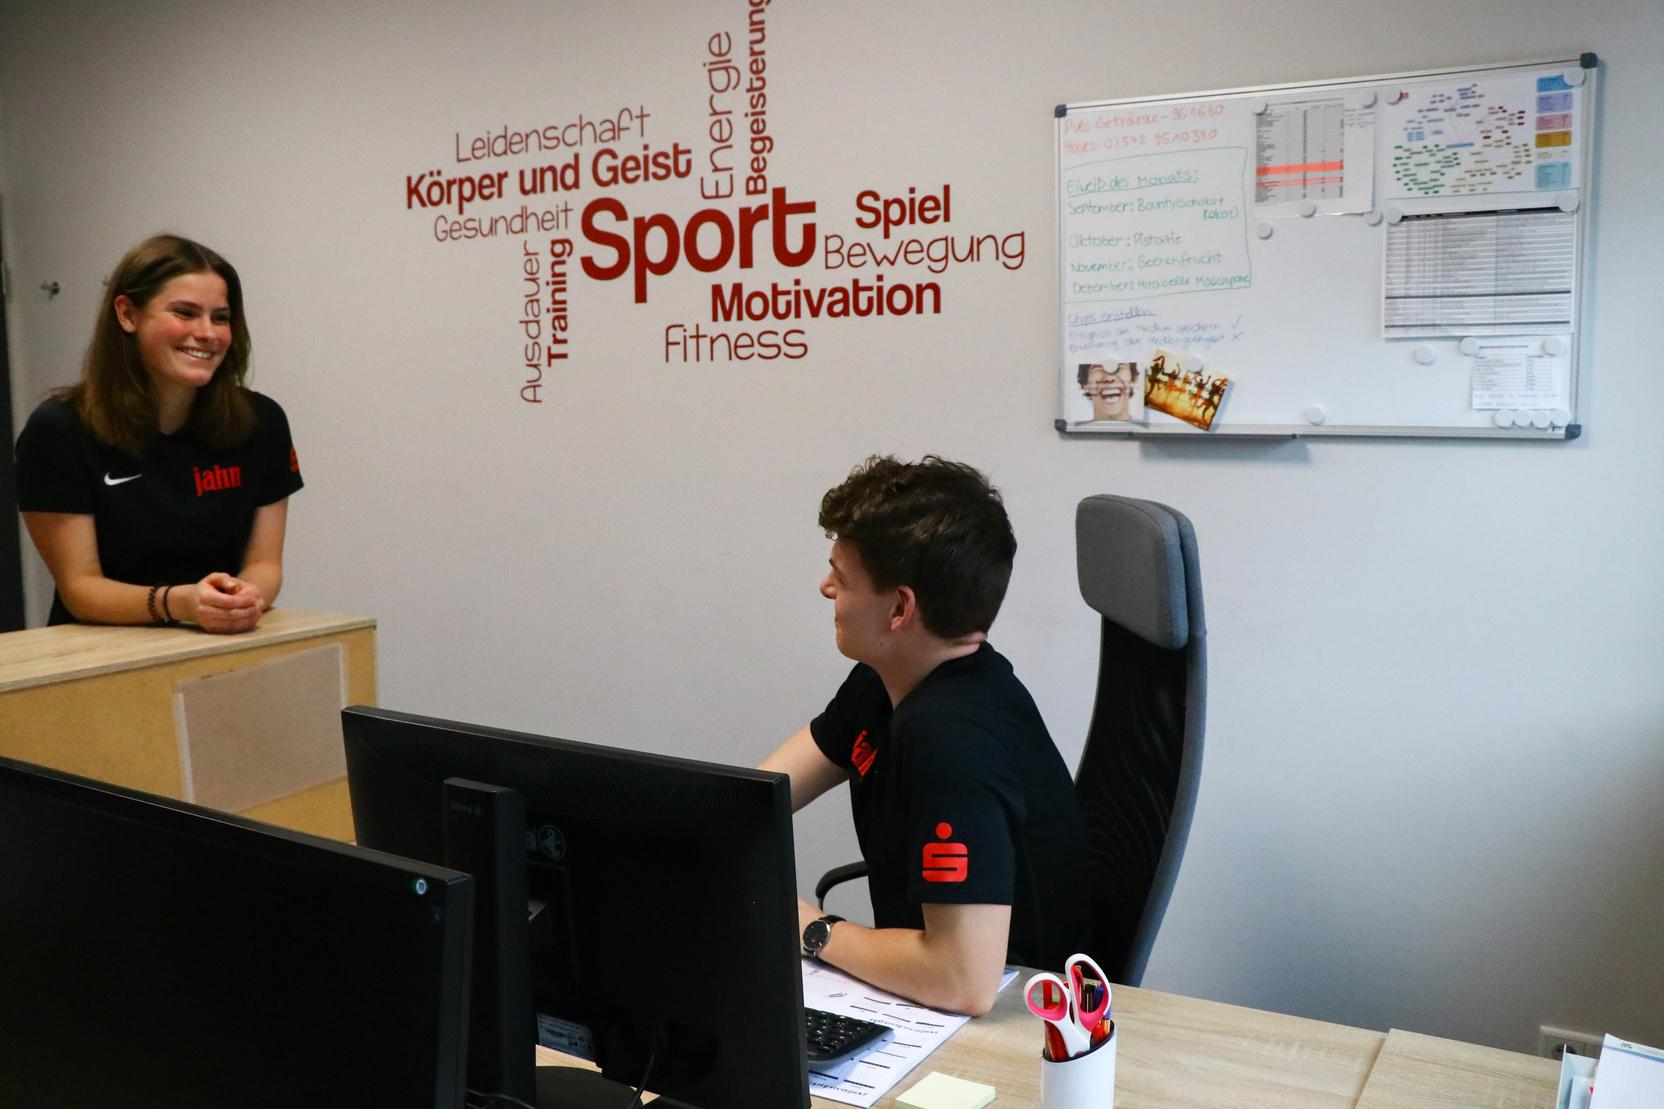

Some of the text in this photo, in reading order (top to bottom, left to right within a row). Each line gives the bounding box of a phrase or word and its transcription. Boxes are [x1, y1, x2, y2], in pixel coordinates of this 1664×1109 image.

[456, 105, 651, 163] Leidenschaft
[699, 31, 741, 200] Energie
[405, 142, 693, 214] Körper und Geist
[433, 201, 573, 244] Gesundheit
[855, 184, 951, 236] Spiel
[579, 186, 816, 304] Sport
[824, 230, 1025, 273] Bewegung
[519, 241, 542, 404] Ausdauer
[546, 238, 574, 367] Training
[710, 275, 942, 323] Motivation
[664, 323, 809, 363] Fitness
[192, 464, 242, 496] jahn
